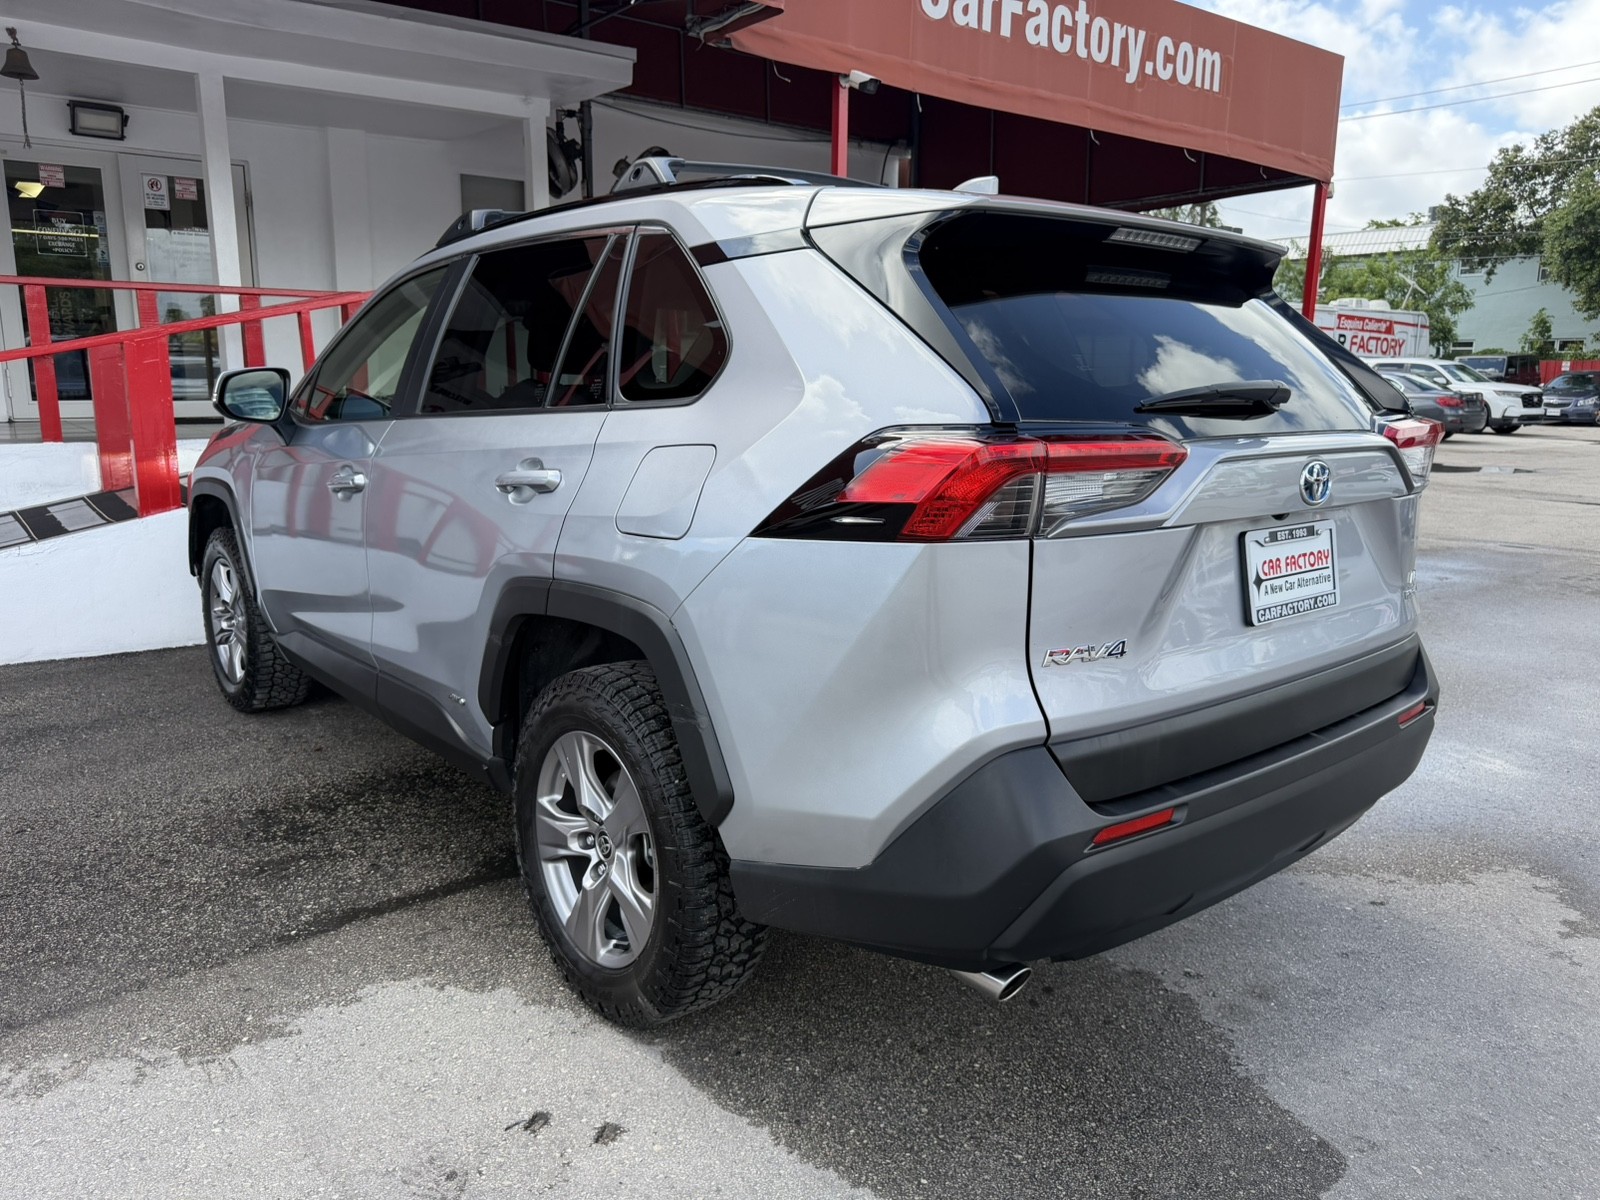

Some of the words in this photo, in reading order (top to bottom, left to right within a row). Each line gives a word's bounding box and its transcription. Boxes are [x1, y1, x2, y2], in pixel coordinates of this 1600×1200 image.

[58, 291, 76, 334] WARDS
[1340, 316, 1363, 331] Esquina
[1349, 334, 1406, 357] FACTORY
[1276, 530, 1292, 541] EST.
[1292, 527, 1308, 539] 1993
[1261, 557, 1282, 577] CAR
[1285, 548, 1330, 573] FACTORY
[1264, 585, 1269, 596] A
[1270, 582, 1283, 595] New
[1285, 580, 1296, 592] Car
[1297, 573, 1332, 588] Alternative
[1258, 593, 1336, 622] CARFACTORY.COM
[1042, 638, 1128, 668] RAV4
